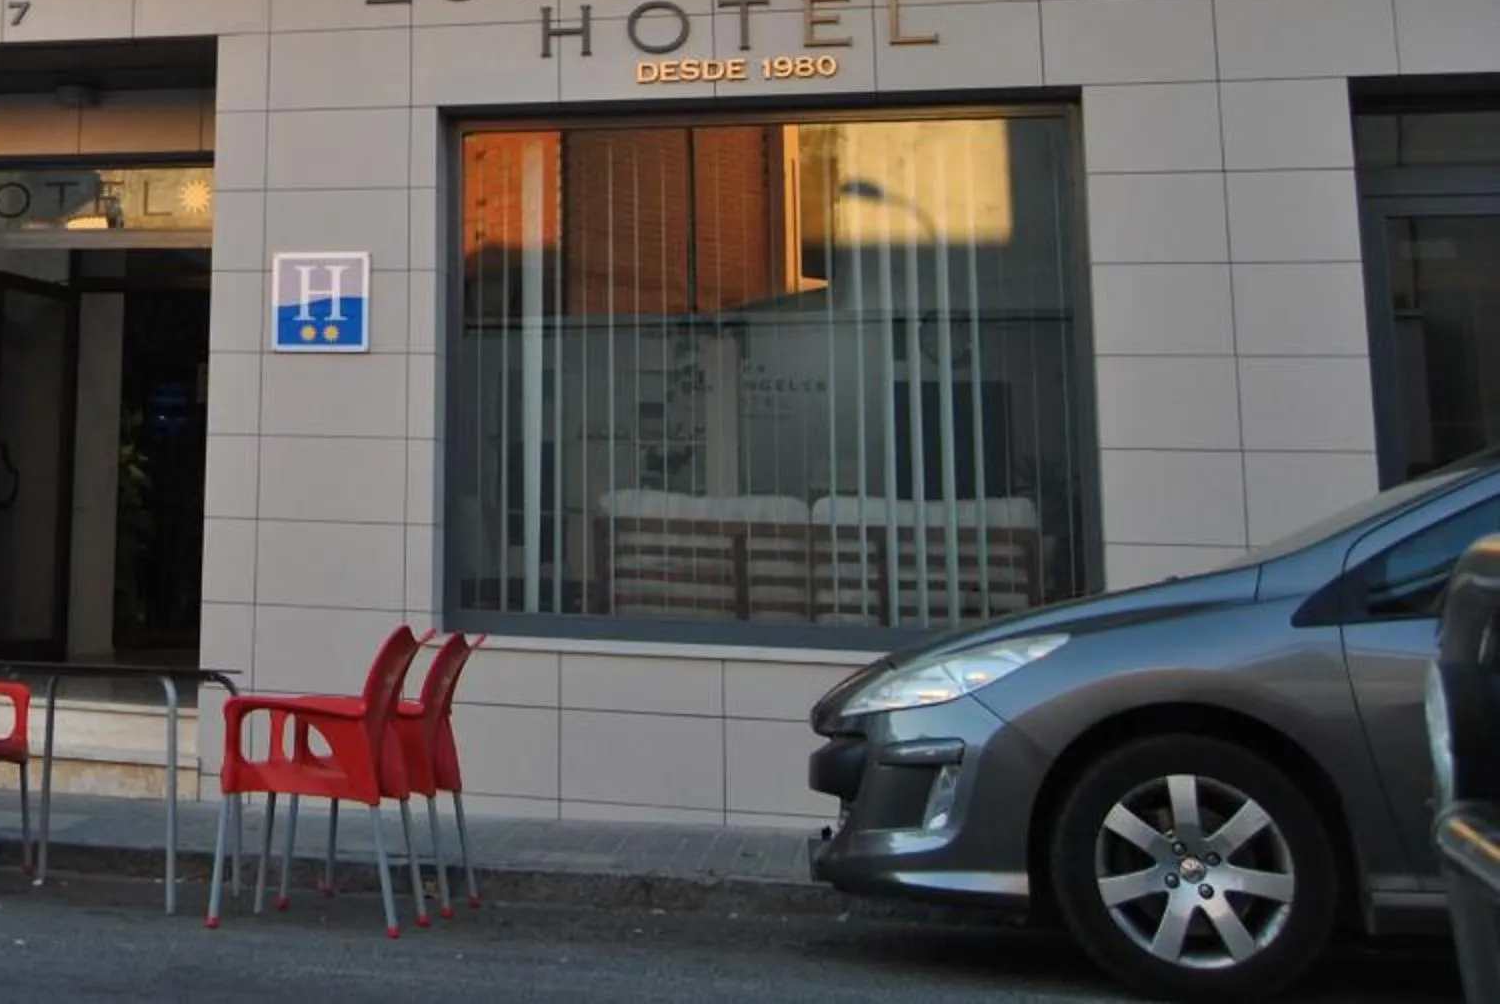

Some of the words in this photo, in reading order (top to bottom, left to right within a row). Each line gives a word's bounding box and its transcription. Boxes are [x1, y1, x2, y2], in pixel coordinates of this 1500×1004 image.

[636, 59, 748, 83] DESDE
[761, 55, 837, 80] 1980
[294, 264, 349, 321] H
